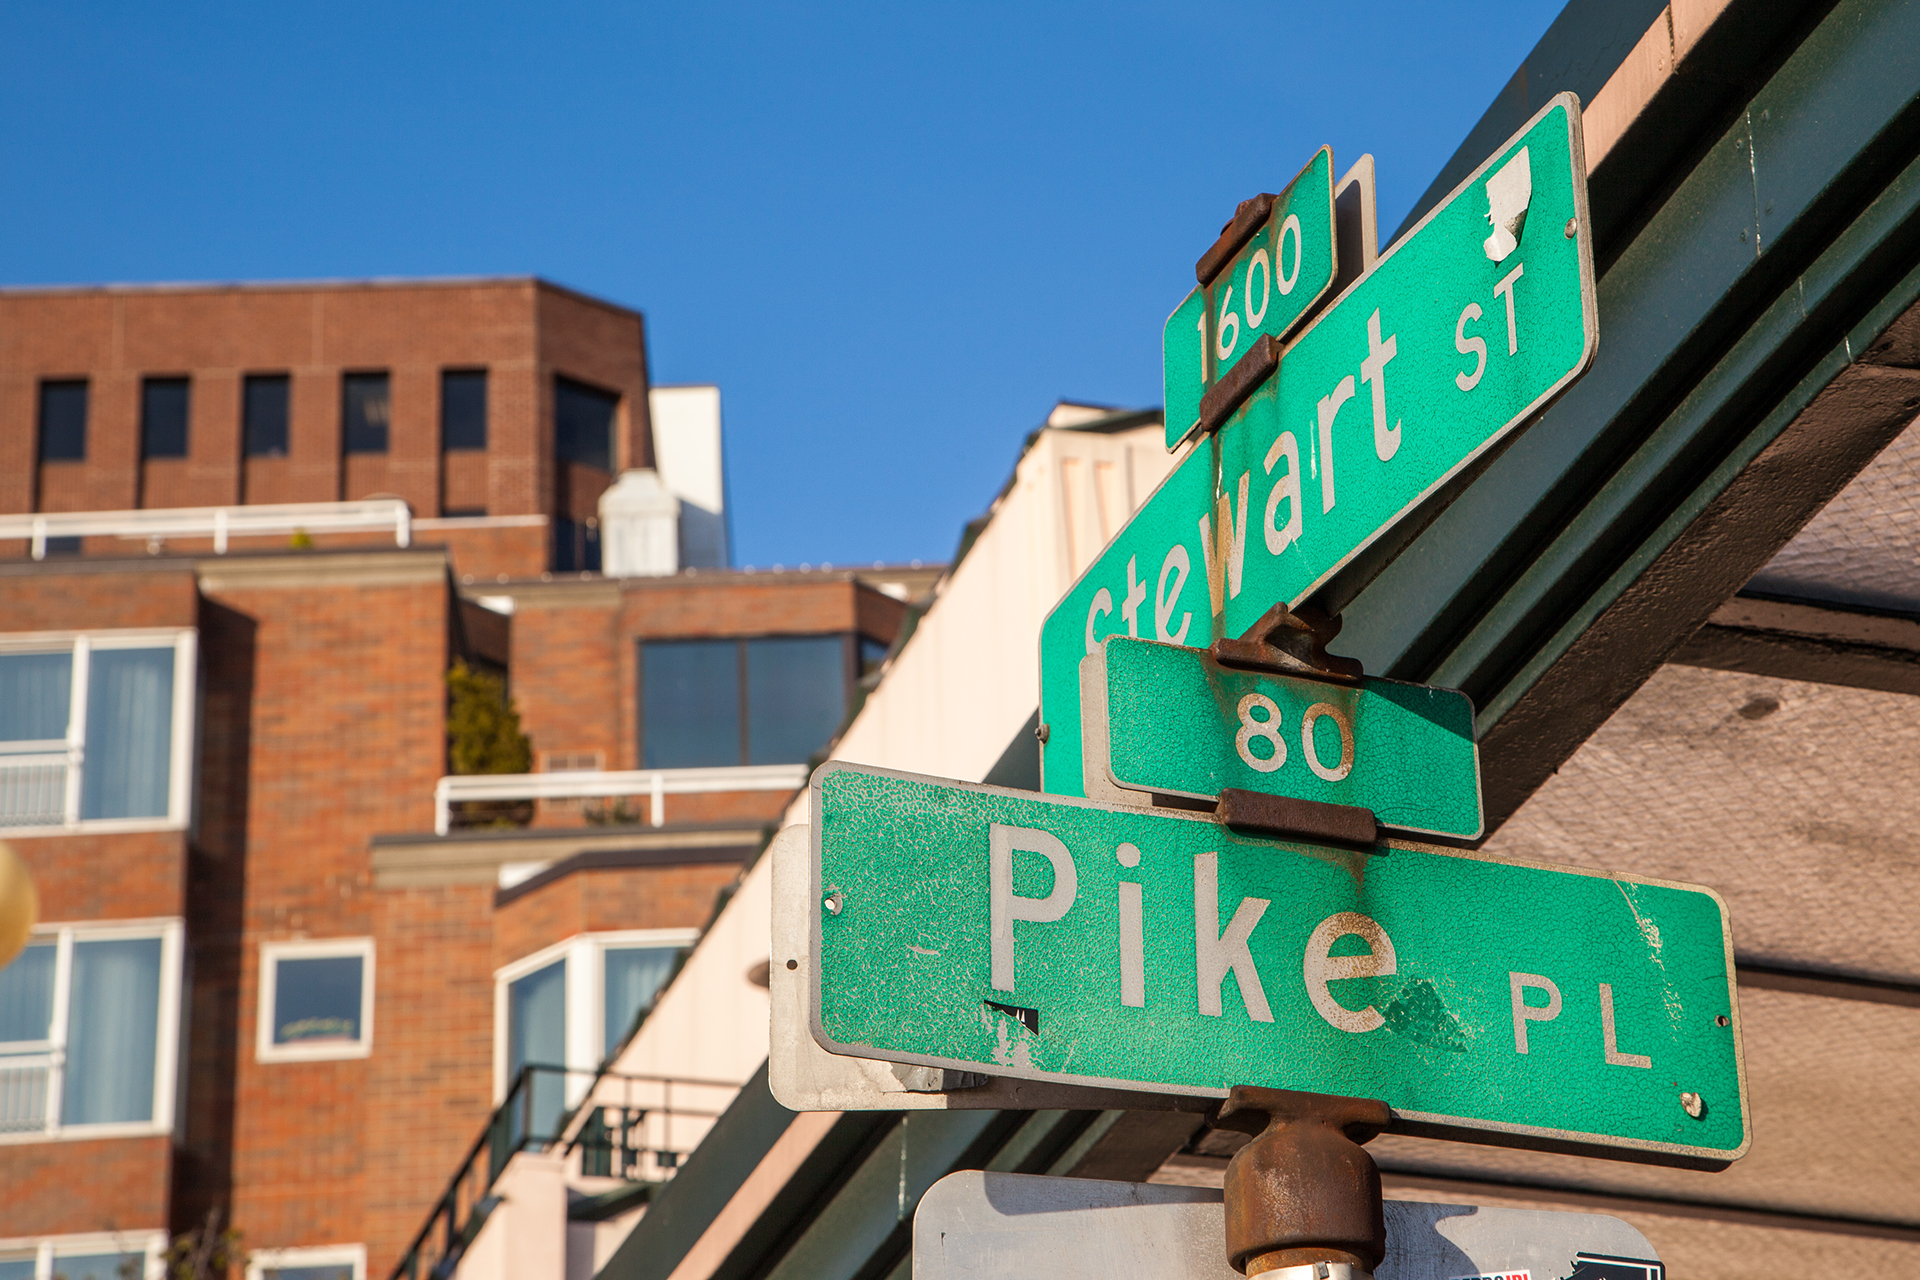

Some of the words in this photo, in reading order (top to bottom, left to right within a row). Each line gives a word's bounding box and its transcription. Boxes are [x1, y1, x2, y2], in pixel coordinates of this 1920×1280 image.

[1197, 214, 1301, 384] 1600
[1455, 263, 1524, 391] ST
[1235, 693, 1356, 782] 80
[989, 823, 1397, 1033] Pike
[1509, 971, 1653, 1069] PL
